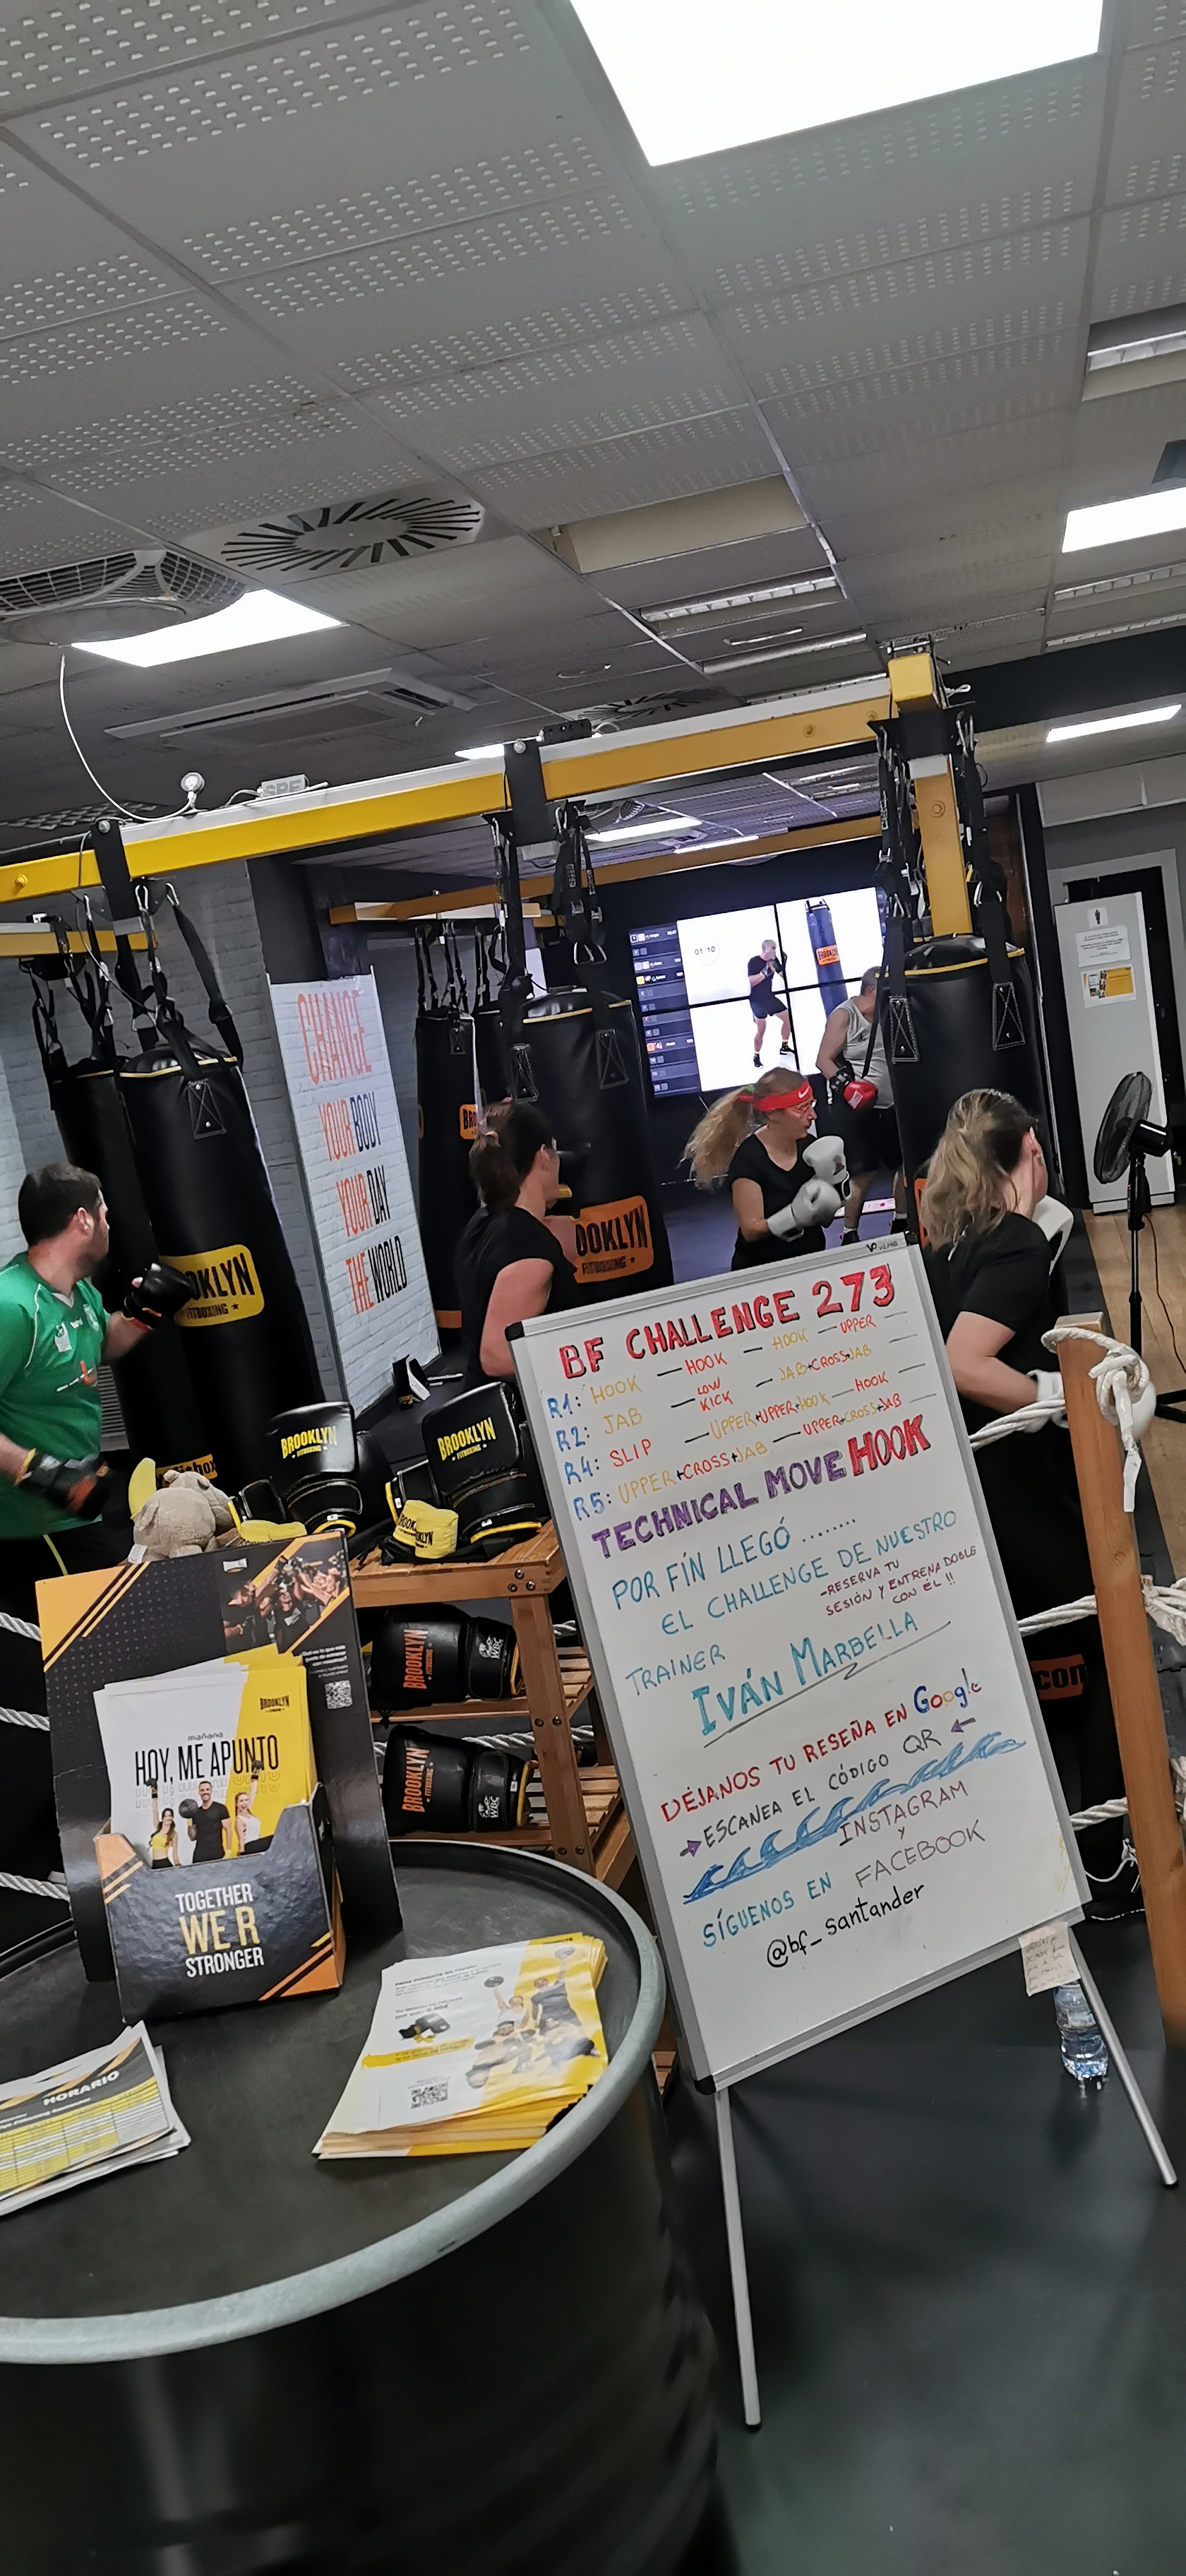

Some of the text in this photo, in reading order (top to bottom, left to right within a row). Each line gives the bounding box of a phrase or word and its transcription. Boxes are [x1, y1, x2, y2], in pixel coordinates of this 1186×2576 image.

[297, 989, 372, 1085] CHANGE
[318, 1091, 381, 1162] YOUR BODY
[336, 1164, 391, 1238] YOUR DAY
[575, 1204, 647, 1257] OOKLYN
[184, 1253, 255, 1301] OKLYN
[346, 1234, 407, 1315] THE WORLD
[558, 1264, 895, 1378] BF CHALLENGE 273
[591, 1376, 643, 1405] HOOK
[685, 1352, 729, 1376] HOOK
[772, 1329, 809, 1349] HOOK
[840, 1315, 877, 1334] UPPER
[697, 1378, 721, 1395] LOW
[281, 1426, 337, 1459] BROOKLYN
[437, 1417, 496, 1461] BROOKLYN
[556, 1426, 590, 1453] R2:
[604, 1409, 643, 1436] JAB
[700, 1390, 735, 1412] KICK
[563, 1456, 600, 1484] R4:
[609, 1439, 652, 1468] SLIP
[855, 1372, 889, 1391] HOOK
[573, 1493, 613, 1522] R5:
[592, 1414, 931, 1559] TECHNICAL MOVE HOOK
[612, 1569, 660, 1611] POR
[717, 1516, 791, 1575] LLEGÓ
[662, 1510, 957, 1635] EL CHALLENGE DE NUESTRO
[825, 1589, 872, 1616] SESIÓN
[888, 1562, 940, 1590] ENTRENA
[943, 1546, 976, 1567] DOBLE
[884, 1559, 899, 1572] TU
[892, 1588, 916, 1604] CON
[403, 1629, 429, 1689] BROOKLYN
[491, 1638, 502, 1659] WBC
[625, 1644, 726, 1696] TRAINER
[789, 1611, 918, 1686] MARBELLA
[135, 1734, 279, 1787] HOY, ME APUNTO
[660, 1668, 983, 1823] DÉJANOS TU RESEÑA EN Google
[402, 1747, 430, 1812] BROOKLYN
[703, 1729, 942, 1849] ESCANEA EL CÓDIGO QR
[839, 1780, 968, 1847] INSTAGRAM
[175, 1883, 253, 1913] TOGETHER
[702, 1818, 986, 1948] SÍGUENOS EN FACEBOOK
[179, 1906, 260, 1955] WE R
[185, 1947, 264, 1978] STRONGER
[42, 2070, 120, 2106] HORARIO
